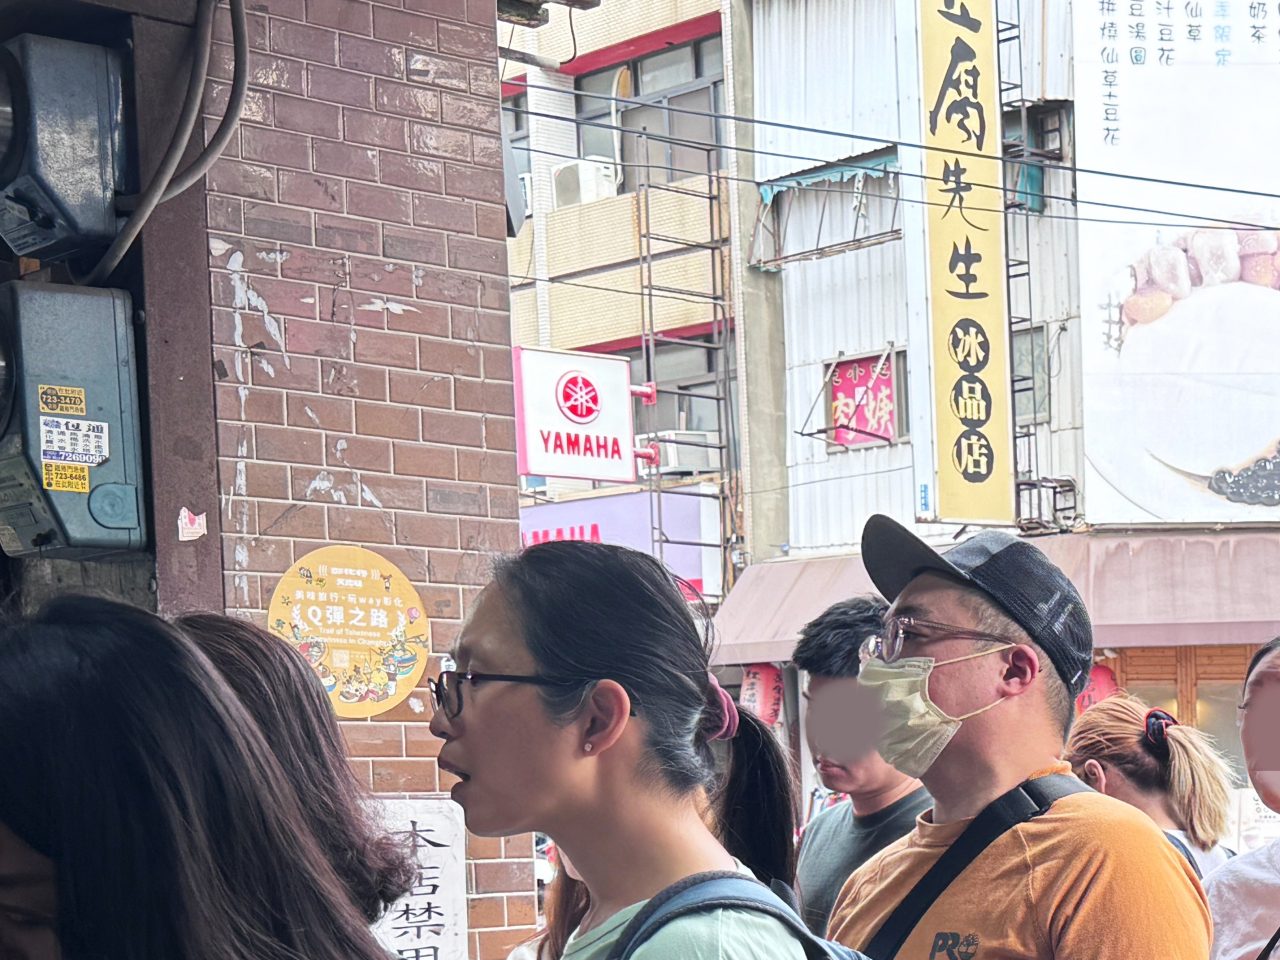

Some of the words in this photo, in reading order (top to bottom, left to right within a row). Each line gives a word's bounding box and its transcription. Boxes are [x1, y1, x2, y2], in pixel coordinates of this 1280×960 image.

[950, 321, 992, 480] 冰品店
[540, 429, 622, 460] YAMAHA
[307, 606, 388, 628] Q彈之路
